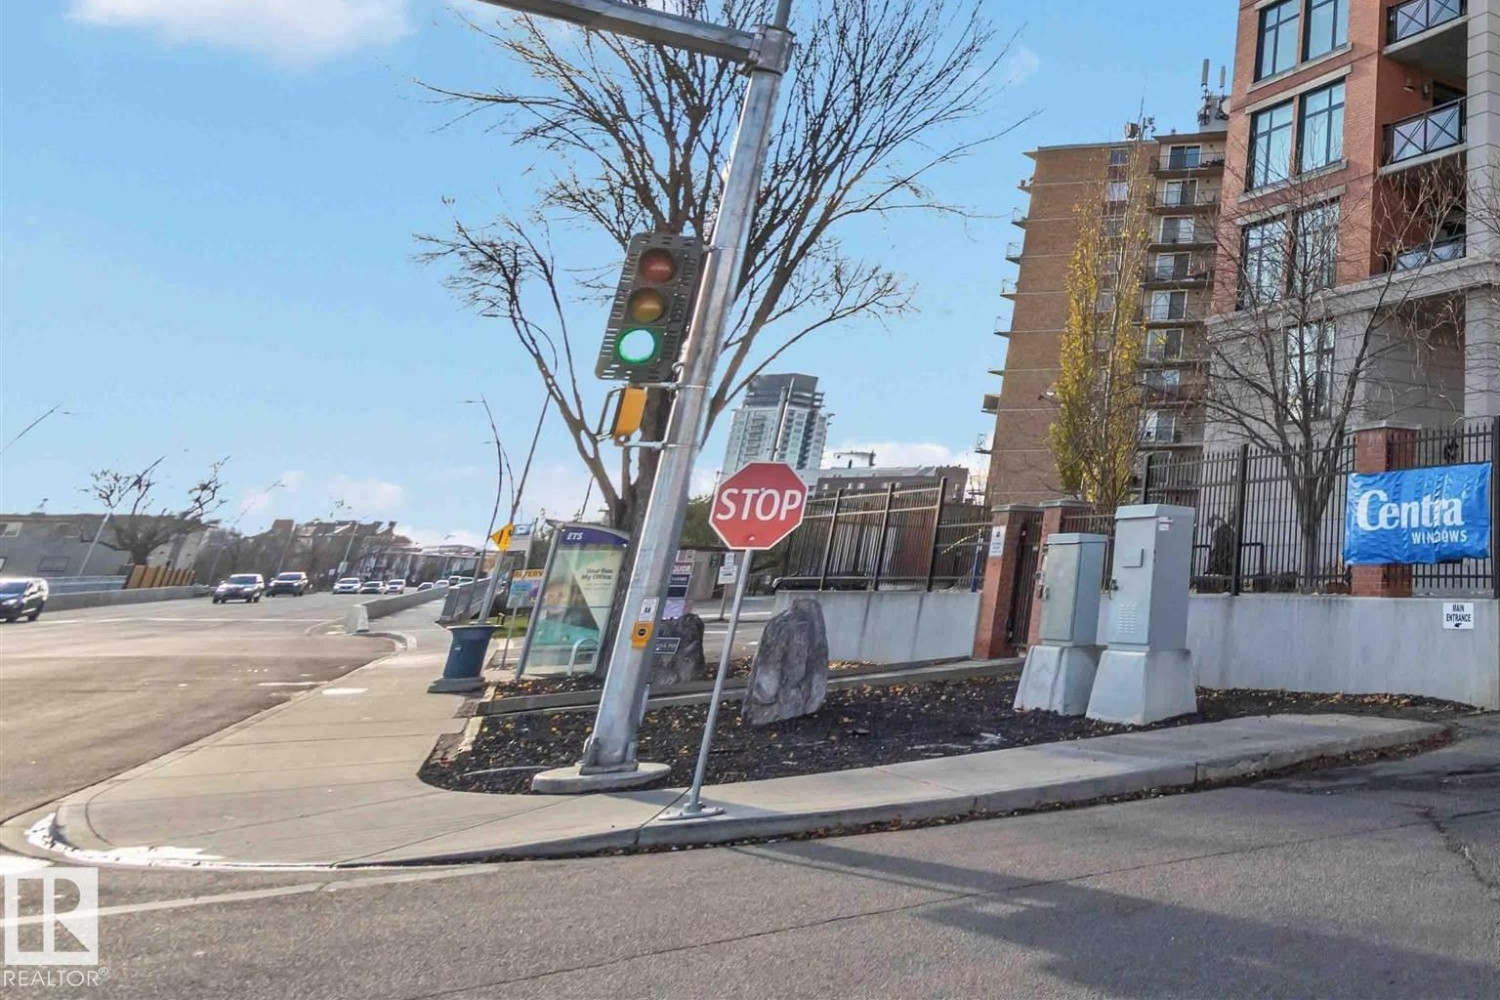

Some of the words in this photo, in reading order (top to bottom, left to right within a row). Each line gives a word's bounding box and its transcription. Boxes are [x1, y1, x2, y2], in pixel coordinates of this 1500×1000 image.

[715, 487, 802, 522] STOP
[1356, 489, 1465, 532] Centra
[566, 532, 583, 540] ETS
[1411, 529, 1468, 545] WINDOWS
[1452, 604, 1465, 612] MAIN
[1446, 612, 1471, 622] ENTRANCE
